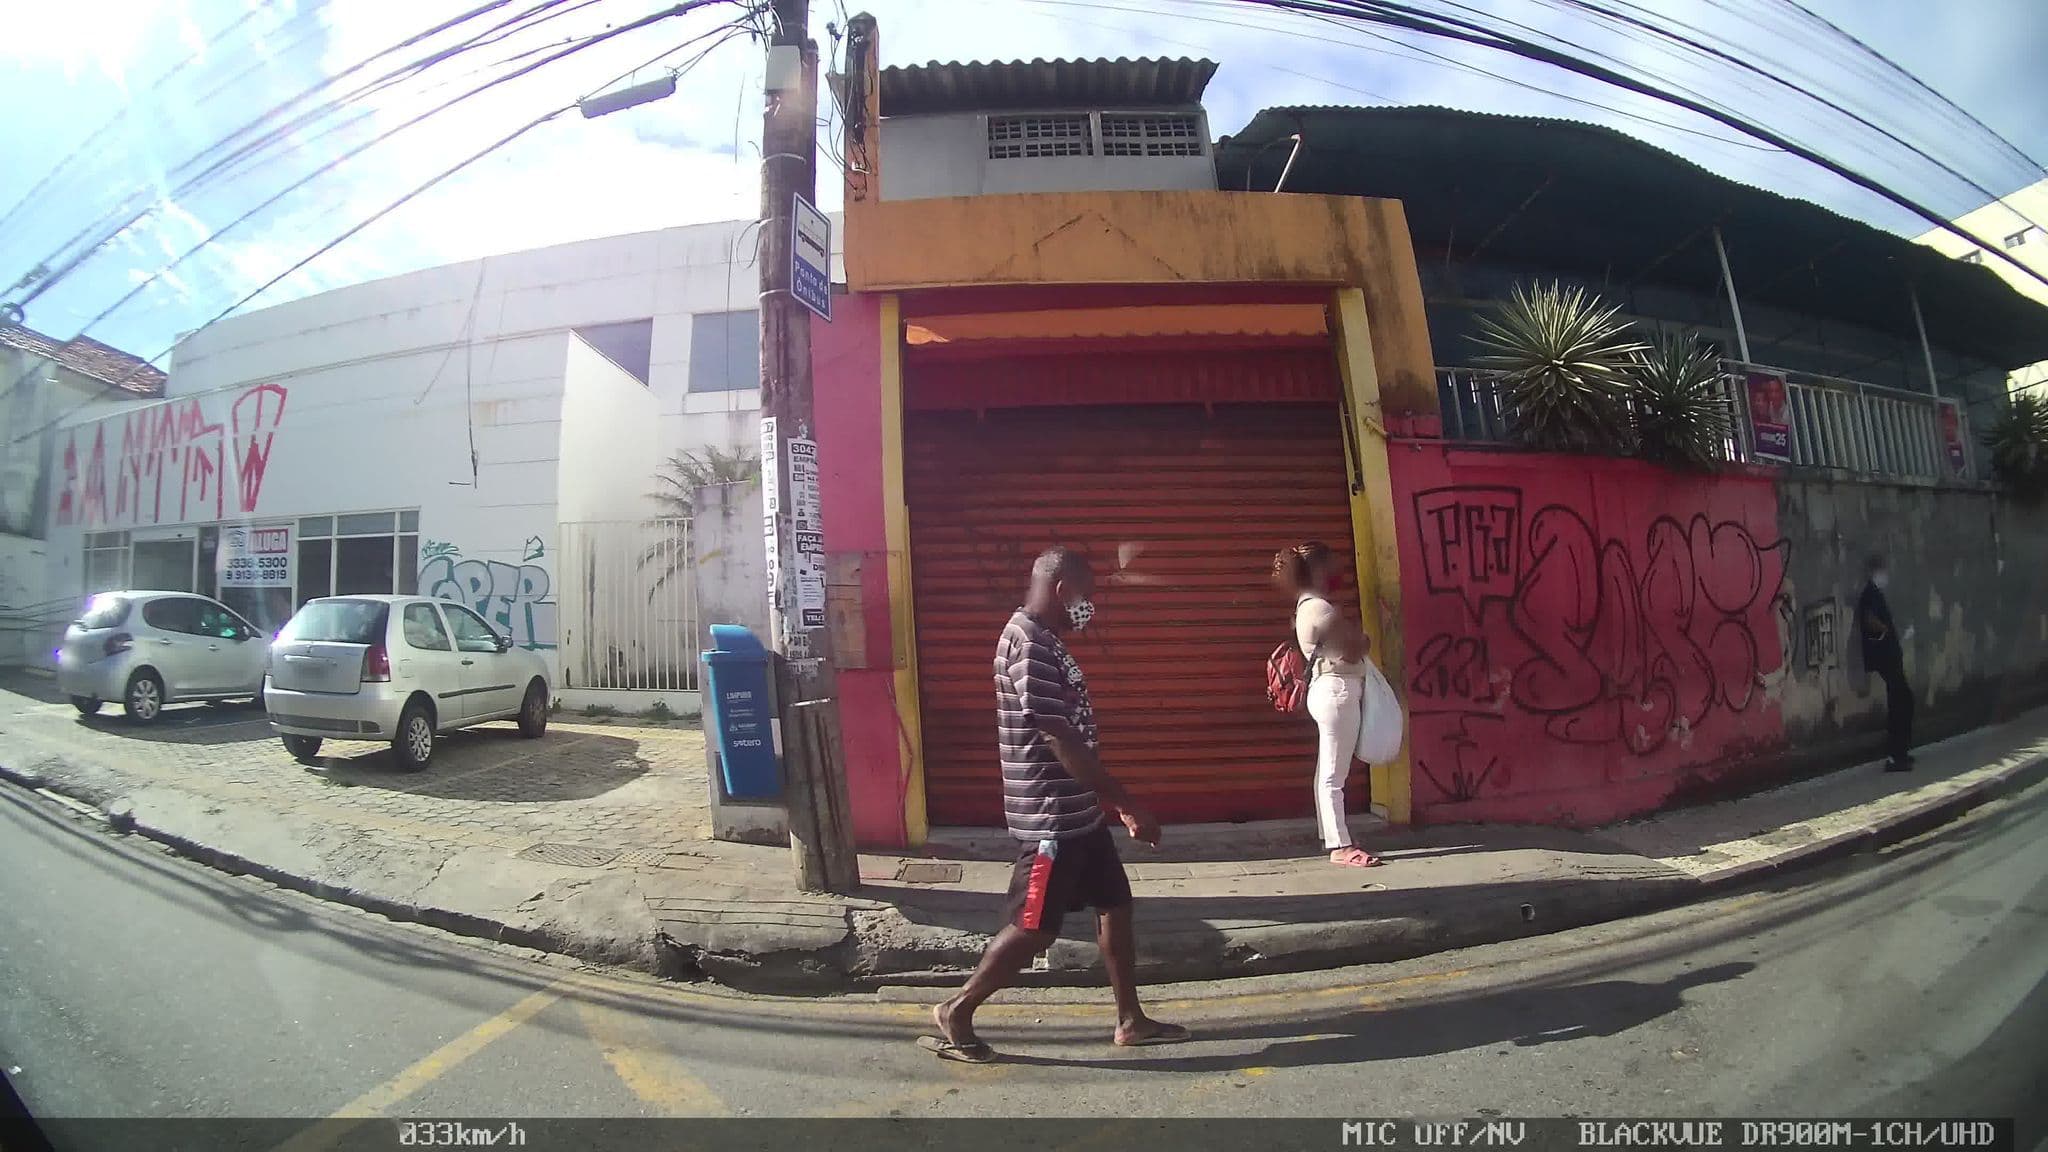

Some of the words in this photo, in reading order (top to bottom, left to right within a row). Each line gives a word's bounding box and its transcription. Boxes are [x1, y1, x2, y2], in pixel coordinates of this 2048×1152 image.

[795, 260, 818, 287] Ponto
[819, 278, 829, 295] de
[796, 277, 826, 308] Ônibus
